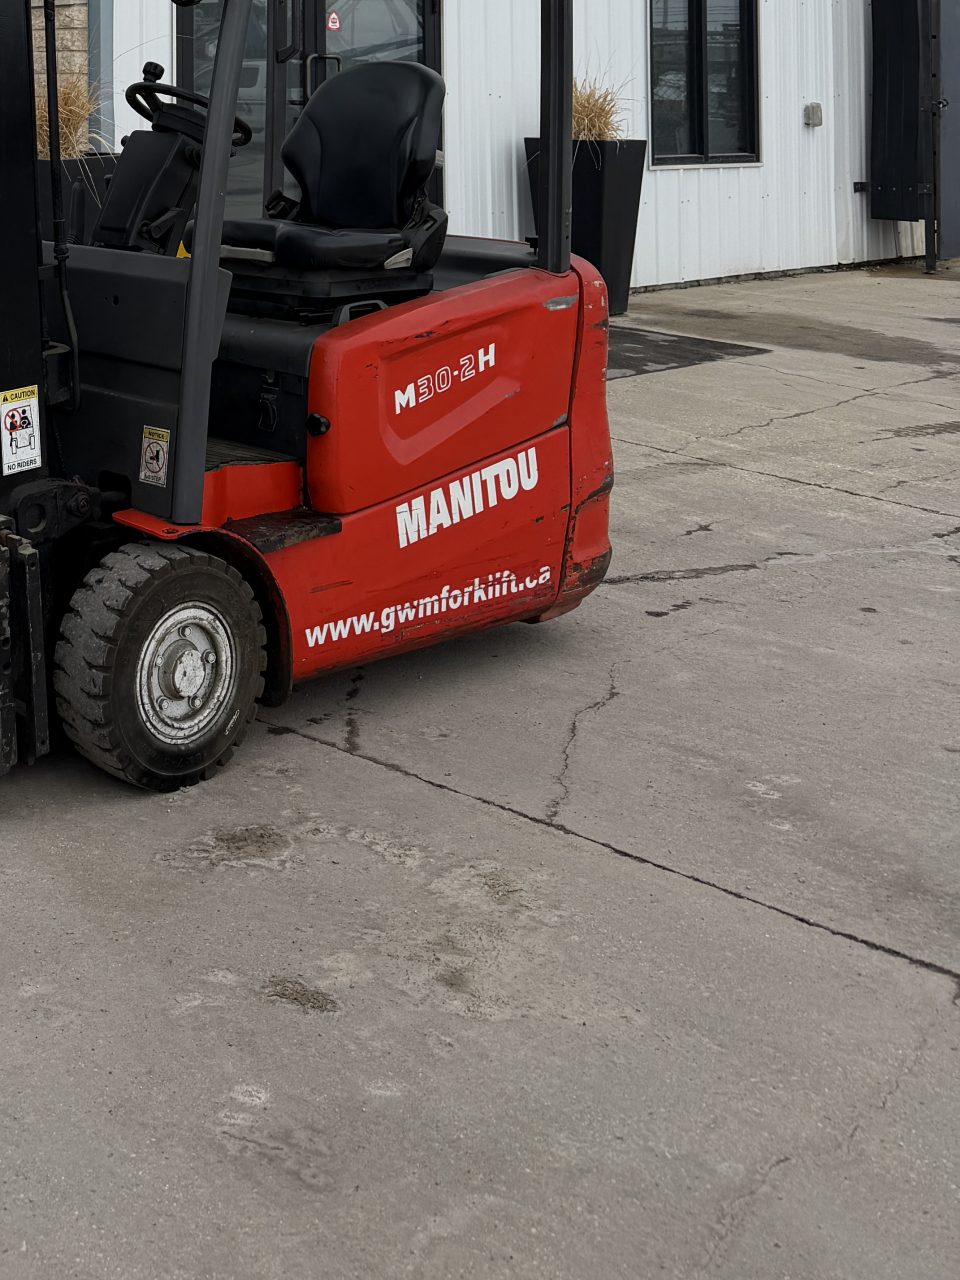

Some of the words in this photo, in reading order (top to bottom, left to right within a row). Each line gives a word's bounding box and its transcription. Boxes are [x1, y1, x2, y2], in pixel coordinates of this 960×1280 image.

[10, 389, 36, 401] CAUTION
[7, 463, 17, 471] NO
[17, 458, 37, 469] RIDERS
[395, 447, 539, 549] MANITOU
